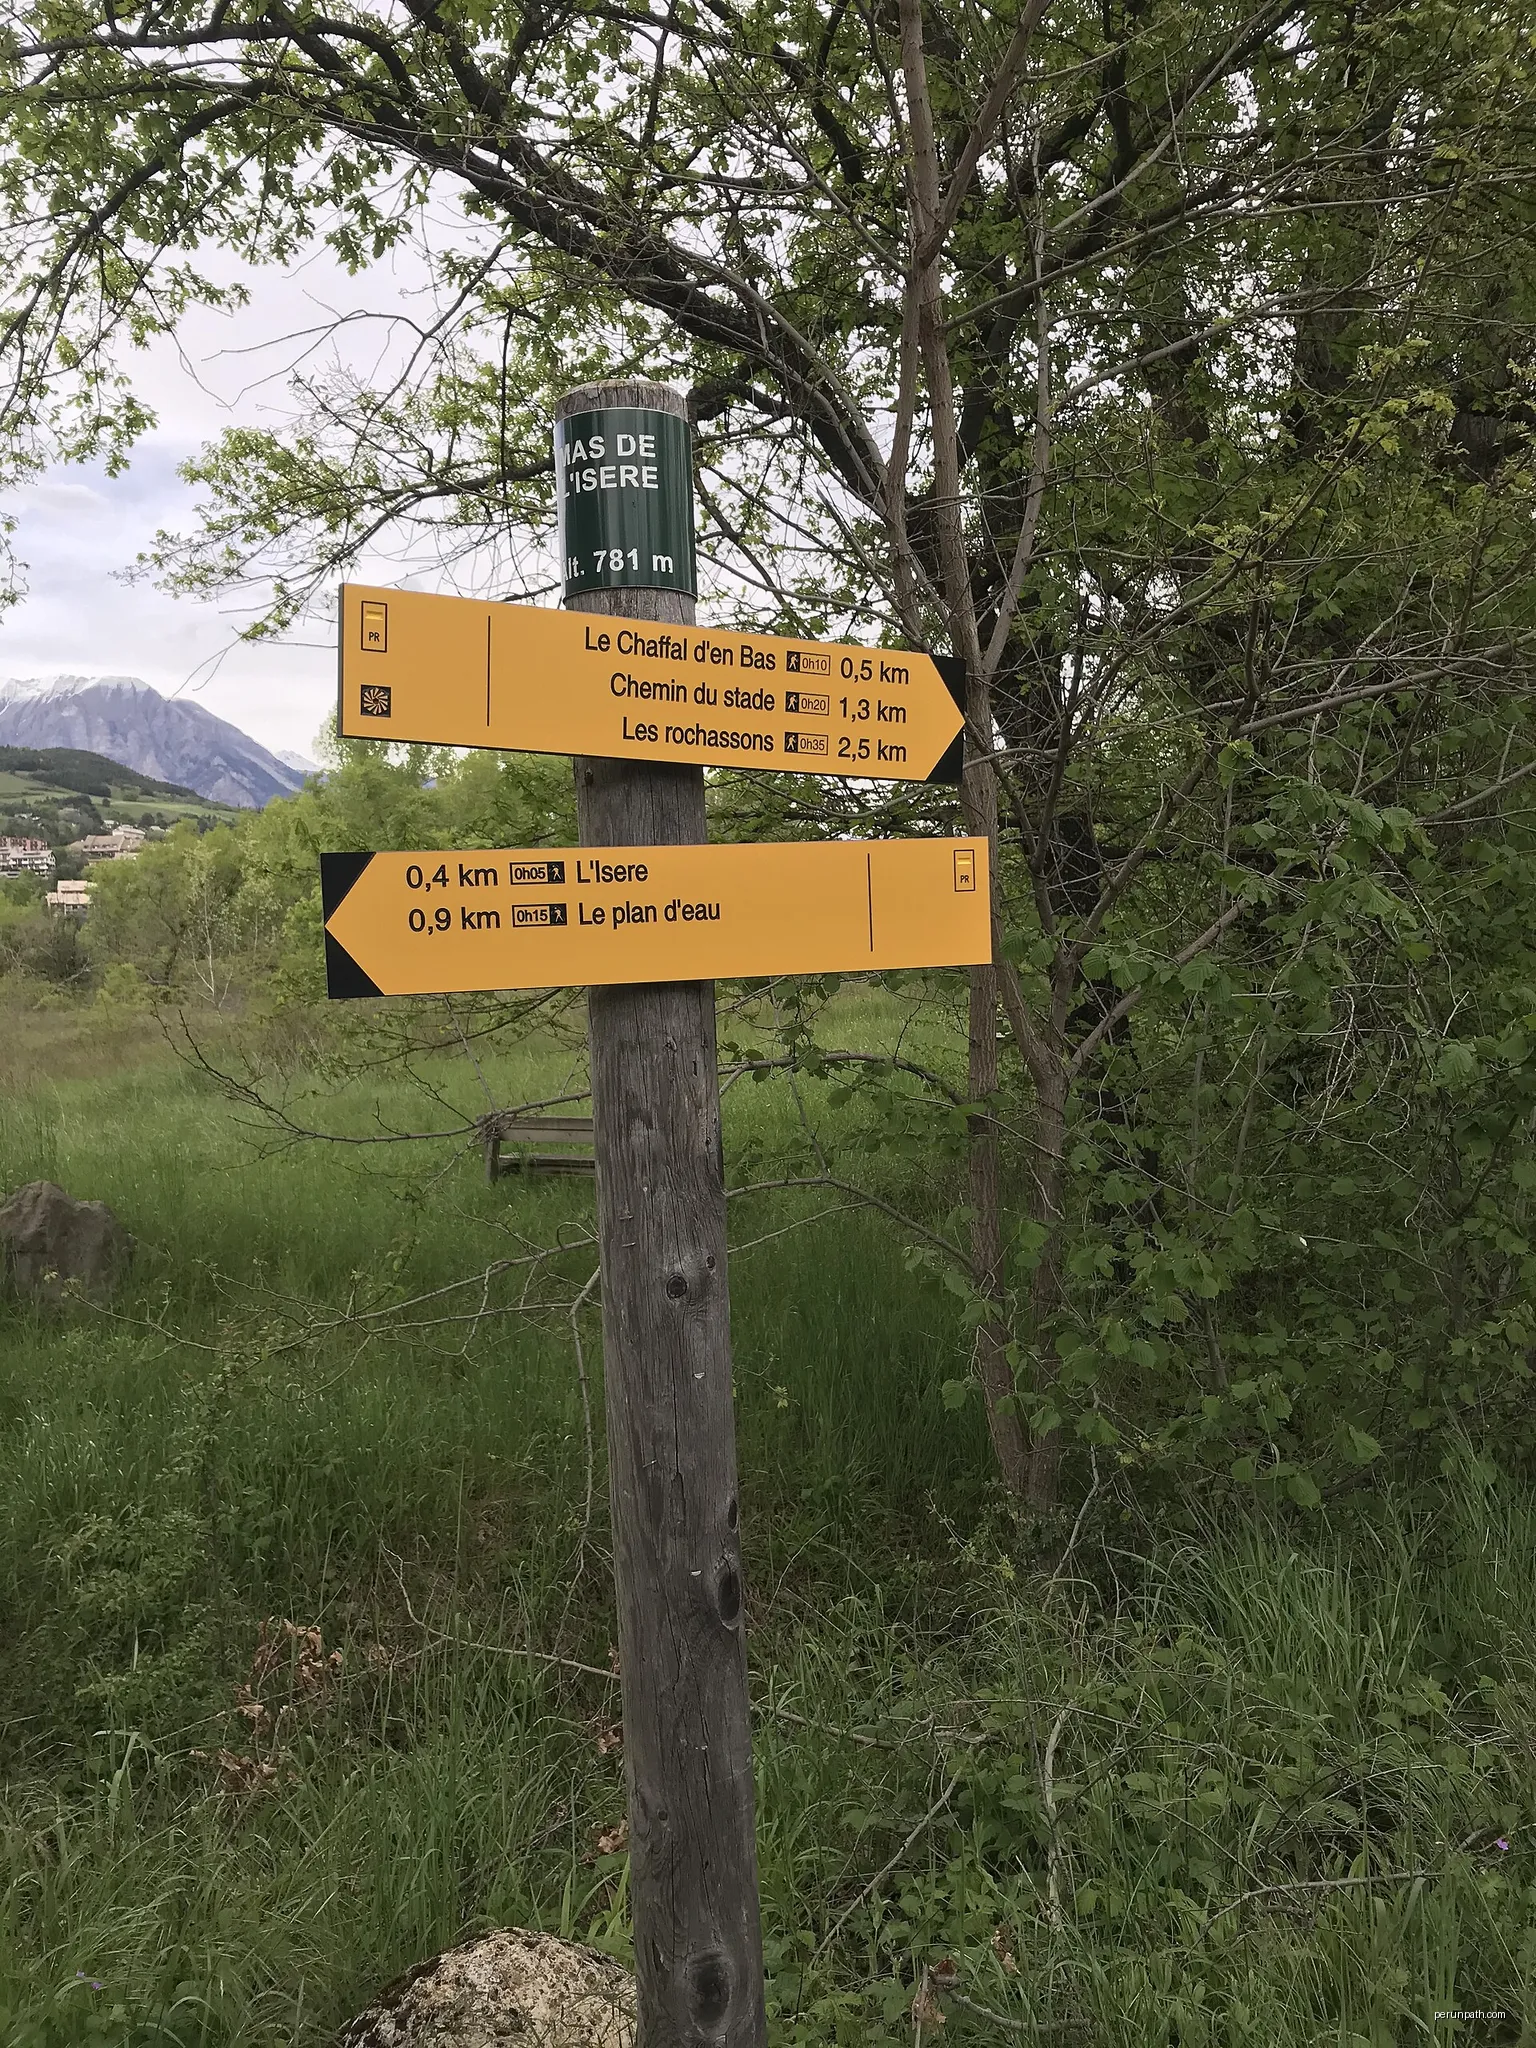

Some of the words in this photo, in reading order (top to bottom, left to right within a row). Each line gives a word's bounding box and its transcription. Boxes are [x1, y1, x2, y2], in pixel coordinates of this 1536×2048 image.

[616, 434, 656, 458] DE
[593, 548, 639, 573] 781
[652, 555, 674, 574] m
[368, 631, 380, 642] PR
[585, 626, 611, 653] Le
[617, 631, 688, 661] Chaffal
[693, 640, 735, 666] d'en
[740, 645, 776, 671] Bas
[802, 657, 828, 671] 0h10
[840, 657, 873, 684] 0,5
[879, 660, 909, 685] km
[610, 673, 688, 703] Chemin
[694, 682, 718, 706] du
[723, 687, 775, 712] stade
[801, 697, 827, 711] 0h20
[839, 697, 870, 723] 1,3
[877, 700, 907, 724] km
[622, 717, 658, 743] Les
[665, 723, 774, 752] rochassons
[799, 738, 825, 751] 0h35
[838, 736, 871, 762] 2,5
[877, 739, 907, 763] km
[405, 864, 450, 893] 0,4
[459, 863, 499, 887] km
[514, 866, 546, 881] 0h05
[576, 860, 649, 884] L'Isere
[960, 874, 970, 884] PR
[408, 907, 452, 936] 0,9
[460, 906, 501, 930] km
[517, 909, 549, 922] 0h15
[579, 902, 606, 926] Le
[612, 900, 658, 930] plan
[663, 899, 721, 922] d'eau
